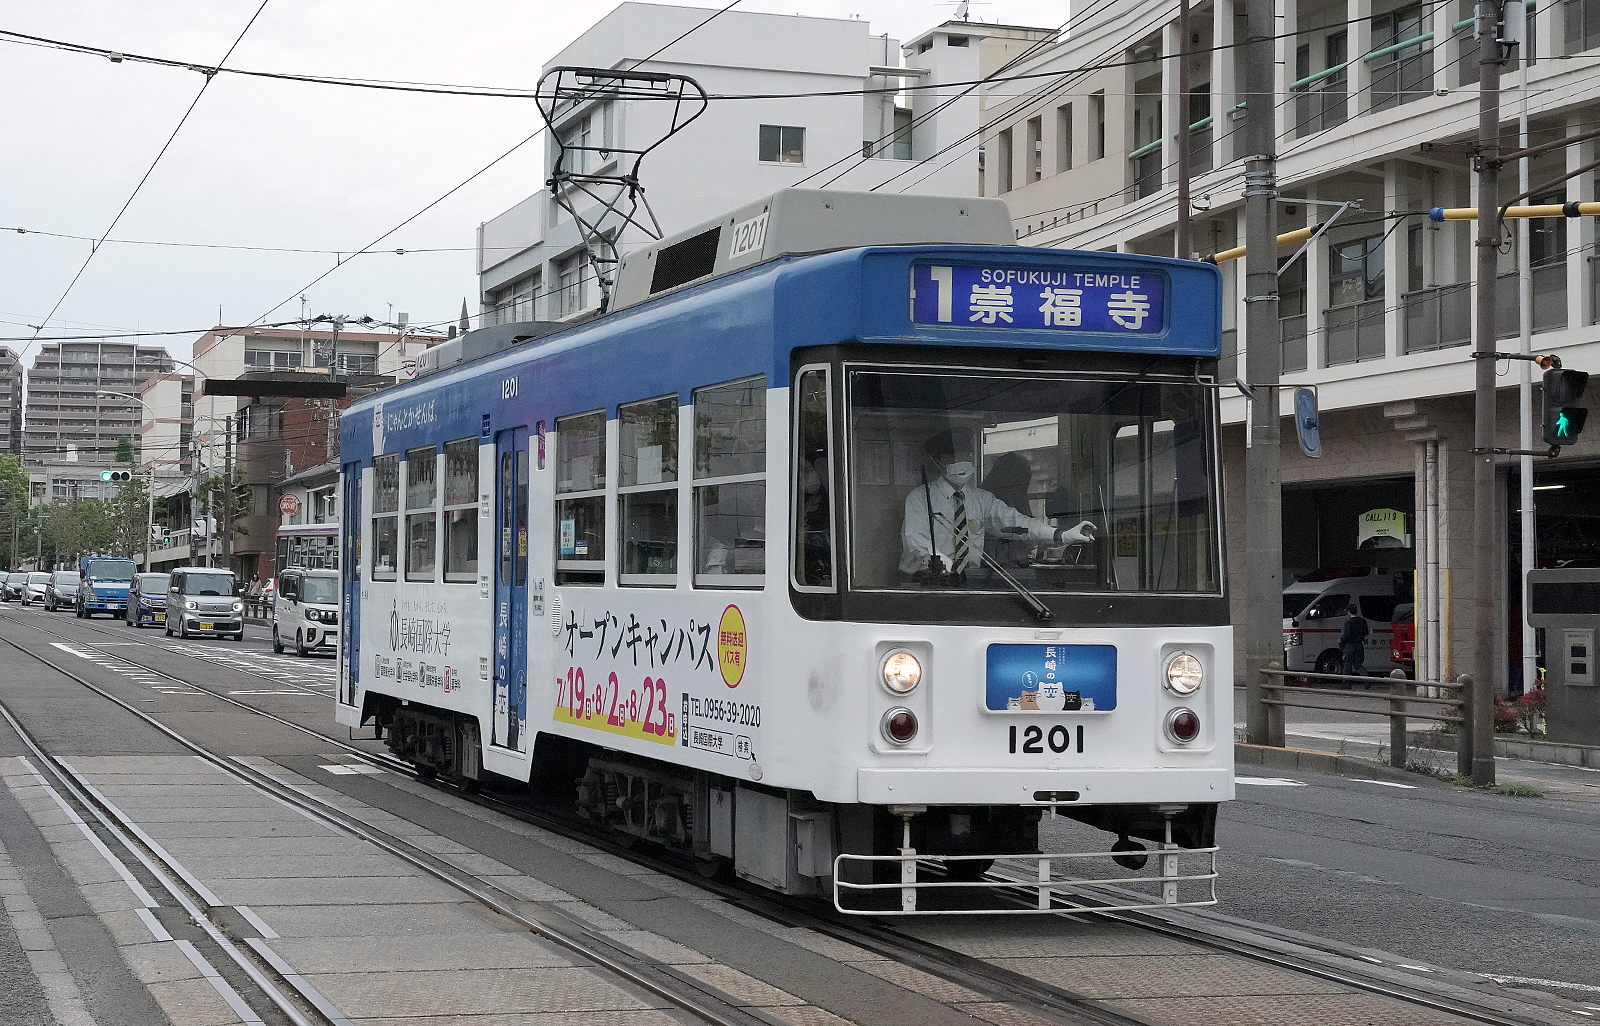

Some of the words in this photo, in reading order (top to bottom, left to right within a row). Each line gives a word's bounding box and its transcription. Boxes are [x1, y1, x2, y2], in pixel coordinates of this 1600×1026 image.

[731, 217, 766, 253] 1201
[931, 266, 953, 322] 1
[981, 269, 1067, 286] SOFUKUJI
[1074, 273, 1140, 289] TEMPLE
[969, 284, 1150, 329] 崇福寺
[501, 376, 519, 399] 1201
[1365, 513, 1382, 522] CALL
[1383, 512, 1397, 521] 119
[400, 617, 451, 657] 長崎国際大学
[565, 610, 714, 672] オープンキャンパス
[690, 697, 761, 728] TEL.0956-39-2020
[1010, 725, 1084, 753] 1201
